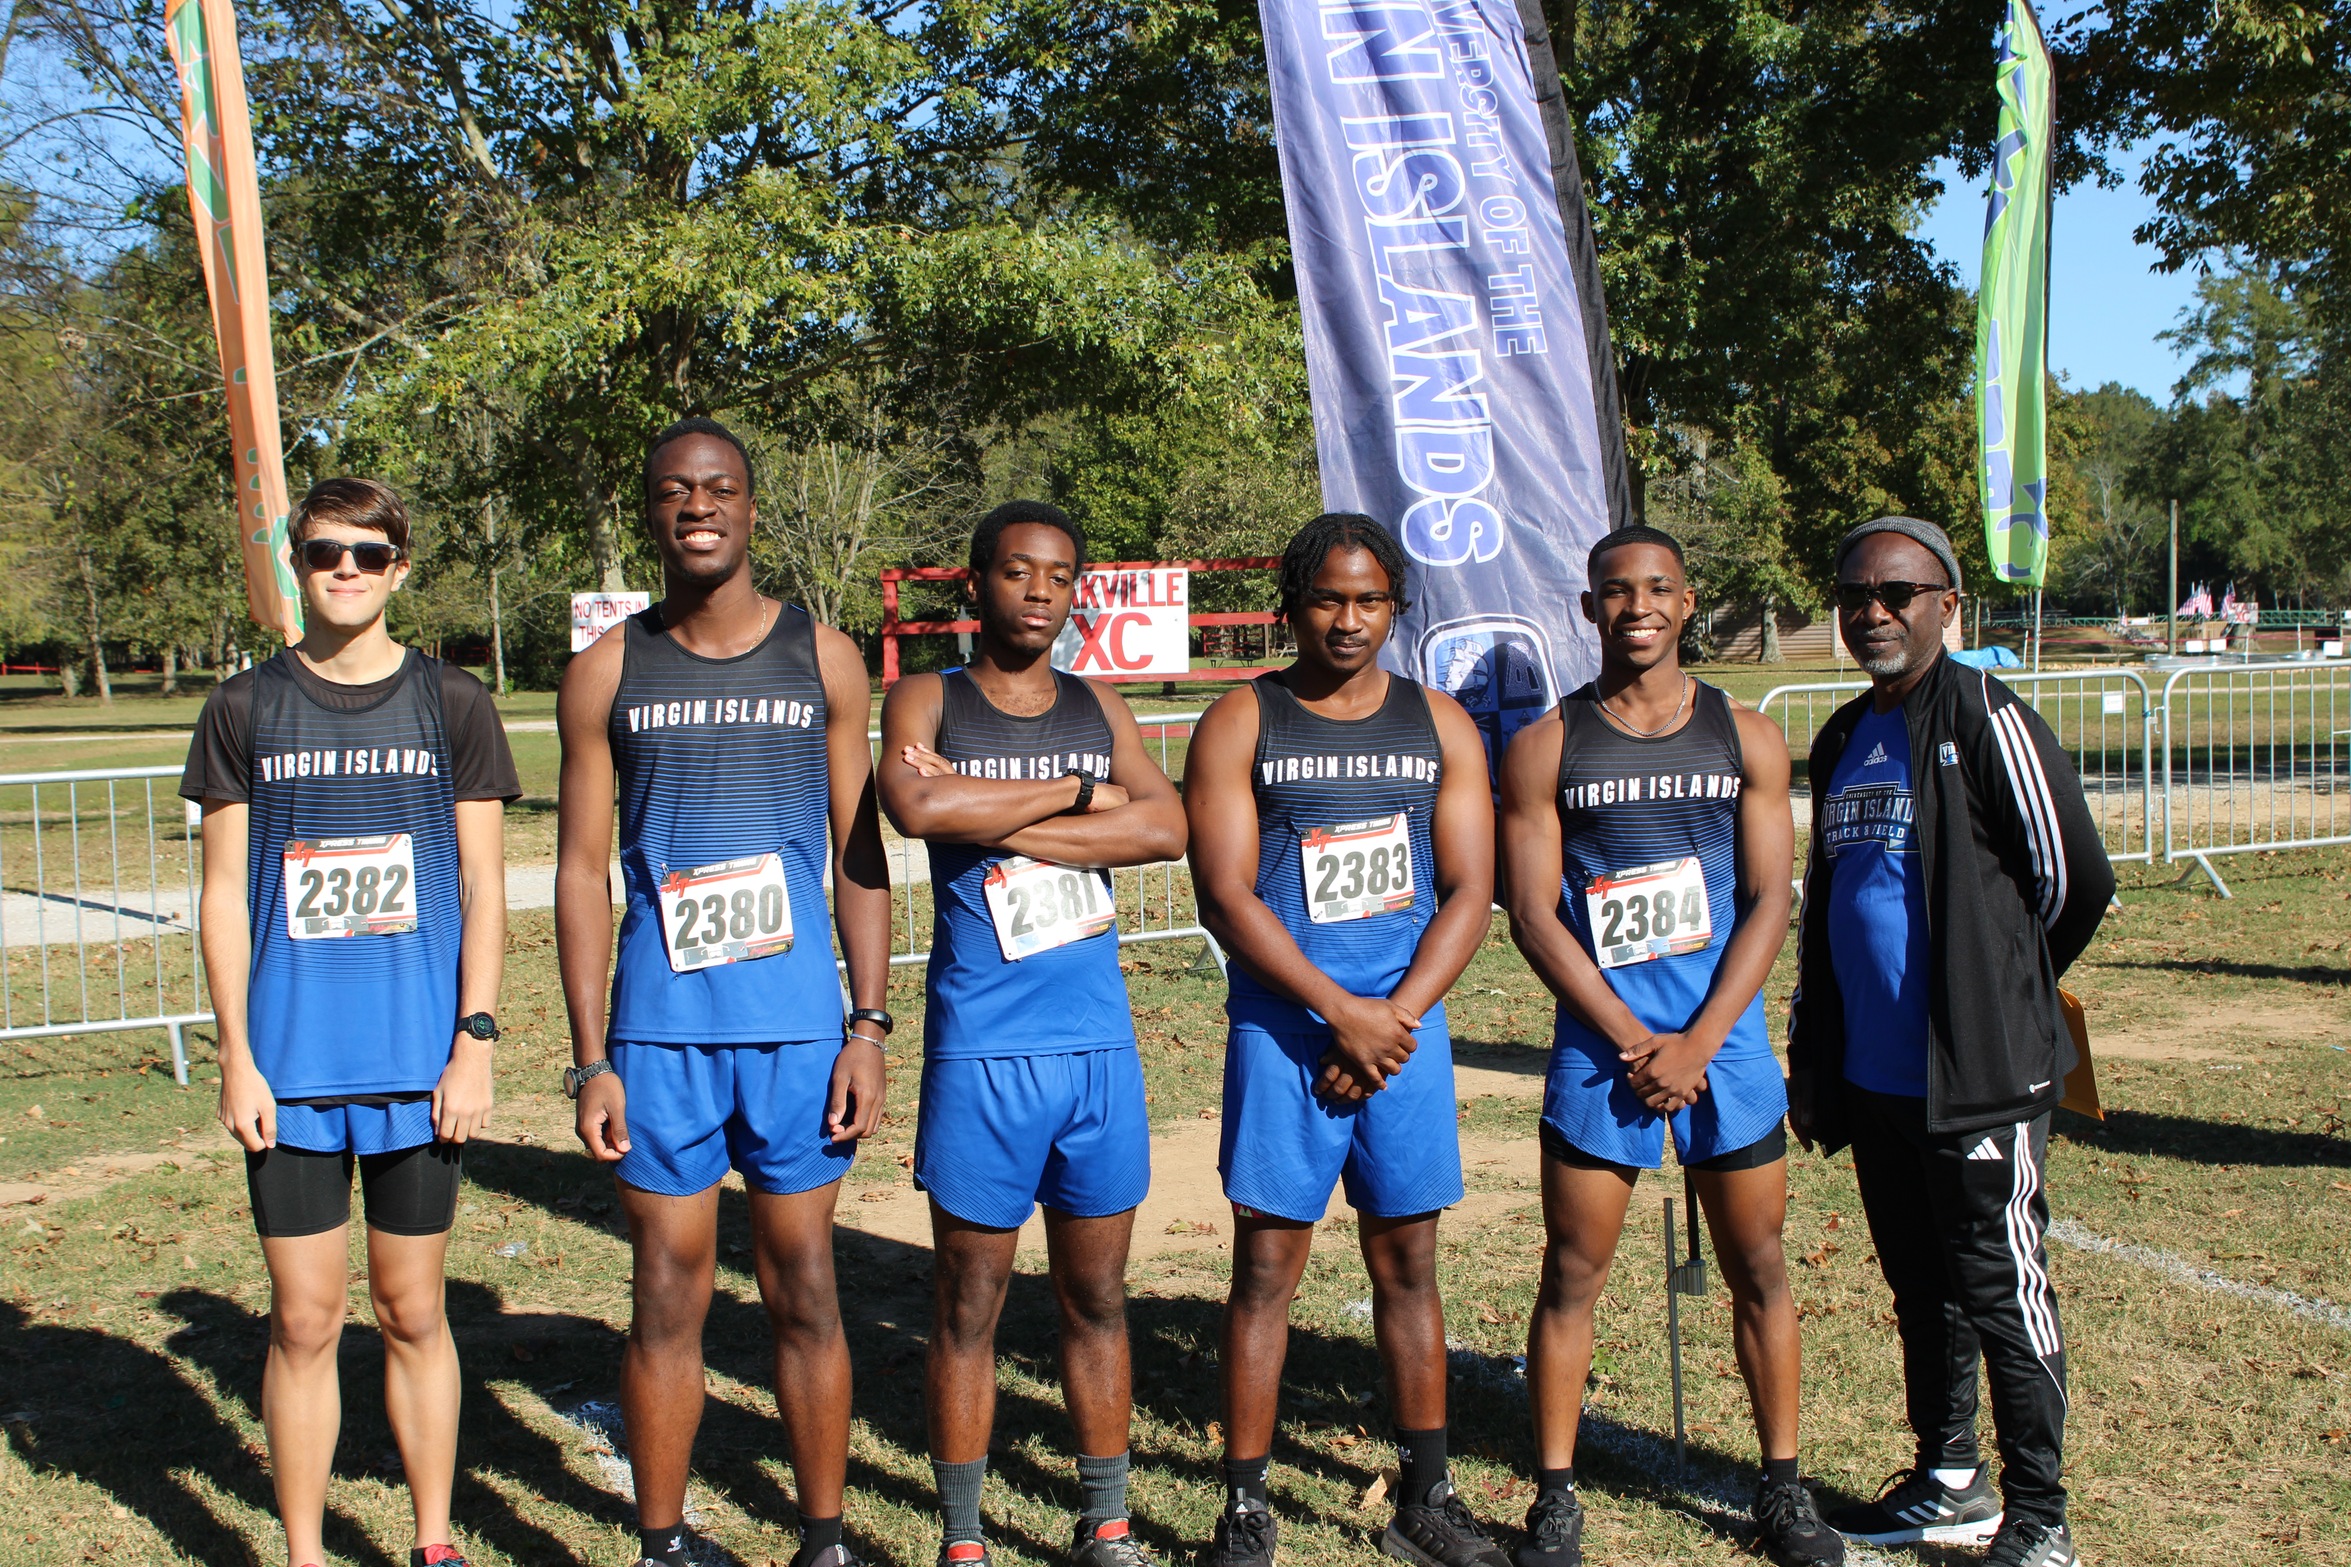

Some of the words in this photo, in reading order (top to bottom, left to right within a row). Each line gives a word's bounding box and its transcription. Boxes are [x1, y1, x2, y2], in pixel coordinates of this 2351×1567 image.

[1479, 194, 1530, 256] OF
[1488, 263, 1548, 358] THE
[1339, 111, 1504, 567] ISLANDS
[574, 601, 592, 619] NO
[595, 600, 632, 618] TENTS
[1070, 612, 1154, 672] XC
[628, 699, 706, 733] VIRGIN
[714, 699, 815, 729] ISLANDS
[261, 750, 337, 782] VIRGIN
[951, 757, 1022, 780] IRGIN
[1029, 753, 1111, 780] ISLANDS
[1262, 756, 1338, 786] VIRGIN
[1346, 755, 1438, 784] ISLANDS
[1863, 755, 1888, 767] adidas
[1564, 777, 1641, 810] VIRGIN
[1649, 774, 1742, 800] ISLANDS
[1306, 828, 1331, 853] XT
[1826, 826, 1859, 844] TRACK
[289, 841, 315, 868] XT
[665, 872, 690, 898] XT
[1314, 843, 1408, 903] 2383
[295, 864, 409, 918] 2382
[1007, 870, 1098, 938] 2381
[674, 883, 783, 951] 2380
[1601, 885, 1702, 948] 2384
